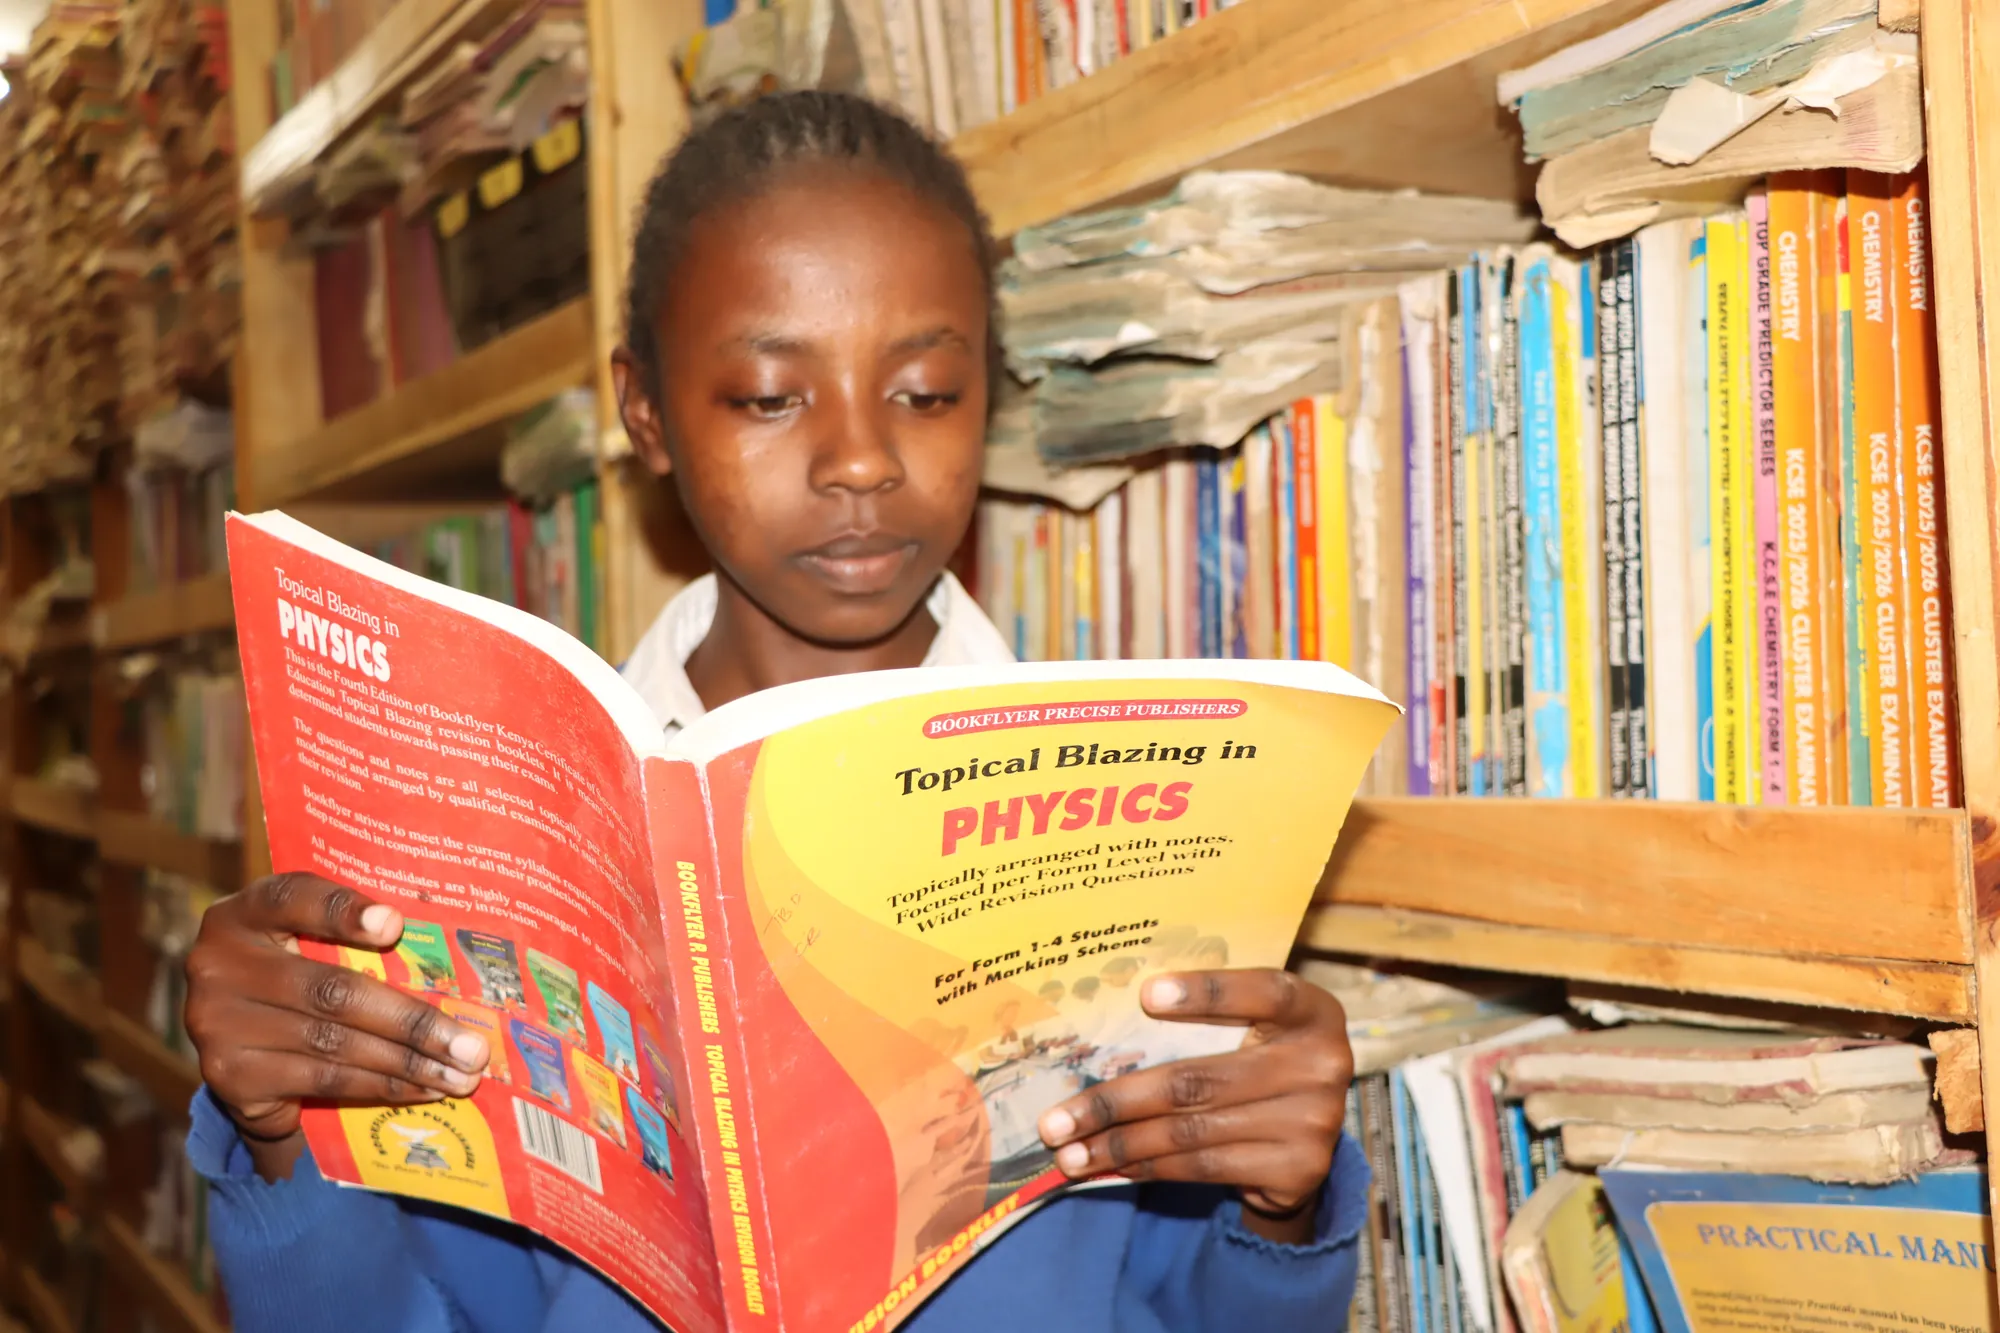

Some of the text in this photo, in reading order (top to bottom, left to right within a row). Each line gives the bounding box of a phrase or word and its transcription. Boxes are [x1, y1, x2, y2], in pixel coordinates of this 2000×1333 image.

[1756, 220, 1769, 250] TOP
[1861, 210, 1883, 323] CHEMISTRY
[1906, 199, 1928, 312] CHEMISTRY
[1757, 257, 1771, 313] GRADE
[1778, 230, 1801, 341] CHEMISTRY
[1758, 318, 1773, 412] PREDICTOR
[1760, 417, 1775, 477] SERIES
[1785, 448, 1806, 499] KCSE
[1869, 432, 1888, 484] KCSE
[1915, 424, 1933, 476] KCSE
[1787, 502, 1810, 611] 2025/2026
[1870, 490, 1893, 598] 2025/2026
[1917, 482, 1938, 593] 2025/2026
[274, 566, 400, 637] Topical Blazing in
[277, 598, 390, 682] PHYSICS
[1923, 597, 1942, 684] CLUSTER
[1764, 605, 1781, 701] CHEMISTRY
[1791, 612, 1813, 698] CLUSTER
[1876, 603, 1897, 689] CLUSTER
[285, 646, 306, 667] This
[307, 657, 316, 672] is
[317, 663, 332, 679] the
[333, 669, 368, 694] Fourth
[370, 685, 413, 711] Edition
[415, 702, 428, 715] of
[430, 705, 494, 732] Bookflyer
[496, 724, 534, 750] Kenya
[535, 741, 585, 785] Certificate
[286, 664, 335, 698] Education
[339, 689, 379, 716] Topical
[385, 707, 433, 736] Blazing
[438, 726, 491, 749] revision
[496, 739, 549, 773] booklets.
[553, 766, 561, 782] It
[288, 682, 559, 794] determined students towards passing their exams.
[928, 702, 1242, 735] BOOKFLYER PRECISE PUBLISHERS
[1767, 707, 1780, 753] FORM
[293, 716, 313, 736] The
[316, 730, 365, 760] questions
[369, 753, 391, 769] and
[396, 763, 429, 781] notes
[435, 774, 456, 787] are
[462, 780, 479, 793] all
[485, 787, 535, 811] selected
[539, 805, 582, 842] topically
[296, 736, 347, 769] moderated
[350, 762, 370, 778] and
[372, 772, 425, 796] arranged
[428, 786, 444, 803] by
[448, 794, 507, 816] qualified
[510, 809, 567, 844] examiners
[569, 838, 580, 853] to
[298, 751, 365, 793] their revision.
[895, 739, 1258, 796] Topical Blazing in
[303, 783, 352, 818] Bookflyer
[354, 811, 391, 833] strives
[393, 825, 406, 837] to
[408, 831, 440, 845] meet
[443, 836, 463, 850] the
[467, 844, 512, 862] current
[515, 856, 561, 883] syllabus
[941, 781, 1195, 858] PHYSICS
[305, 802, 591, 918] deep research in compilation of all their productions.
[311, 835, 326, 851] All
[328, 845, 371, 874] aspiring
[374, 863, 440, 889] candidates
[445, 882, 466, 894] are
[470, 884, 511, 906] highly
[515, 900, 579, 936] encouraged
[581, 932, 592, 946] to
[313, 852, 338, 875] every
[339, 866, 378, 889] subject
[379, 879, 397, 894] for
[475, 900, 489, 912] in
[490, 905, 541, 931] revision.
[676, 860, 706, 939] BOOKFLYER
[887, 834, 1234, 909] Topically arranged with notes,
[895, 847, 1223, 926] Focused per Form Level with
[916, 863, 1197, 935] Wide Revision Questions
[934, 916, 1160, 990] For Form 1-4 Students
[936, 934, 1153, 1006] with Marking Scheme
[691, 956, 721, 1035] PUBLISHERS
[705, 1044, 730, 1094] TOPICAL
[713, 1097, 739, 1149] BLAZING
[722, 1151, 742, 1166] IN
[725, 1167, 749, 1214] PHYSICS
[733, 1214, 757, 1266] REVISION
[921, 1192, 1021, 1280] BOOKLET
[1697, 1223, 1895, 1258] PRACTICAL
[741, 1267, 765, 1316] BOOKLET
[1900, 1312, 1919, 1325] has
[1921, 1316, 1946, 1330] been
